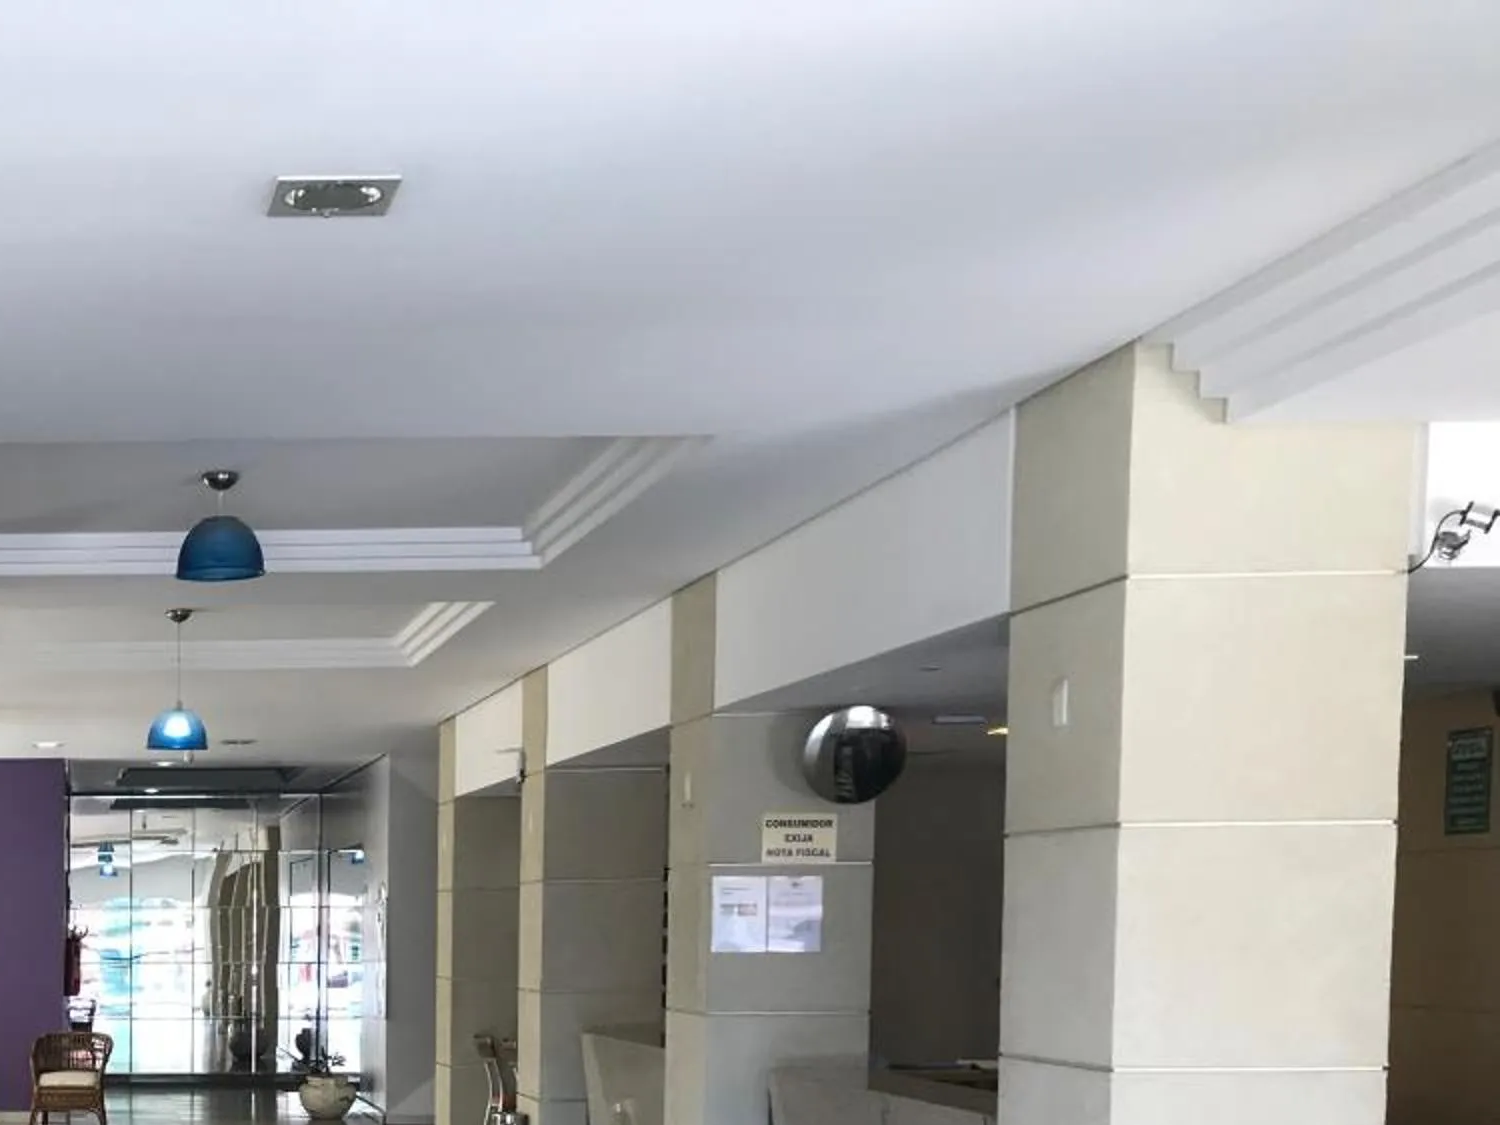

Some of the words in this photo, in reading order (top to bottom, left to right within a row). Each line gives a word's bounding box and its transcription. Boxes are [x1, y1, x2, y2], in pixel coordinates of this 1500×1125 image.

[765, 819, 834, 829] CONSUMIDOR
[784, 833, 813, 843] EXIJA
[765, 847, 793, 857] NOTA
[796, 847, 831, 857] FISCAL
